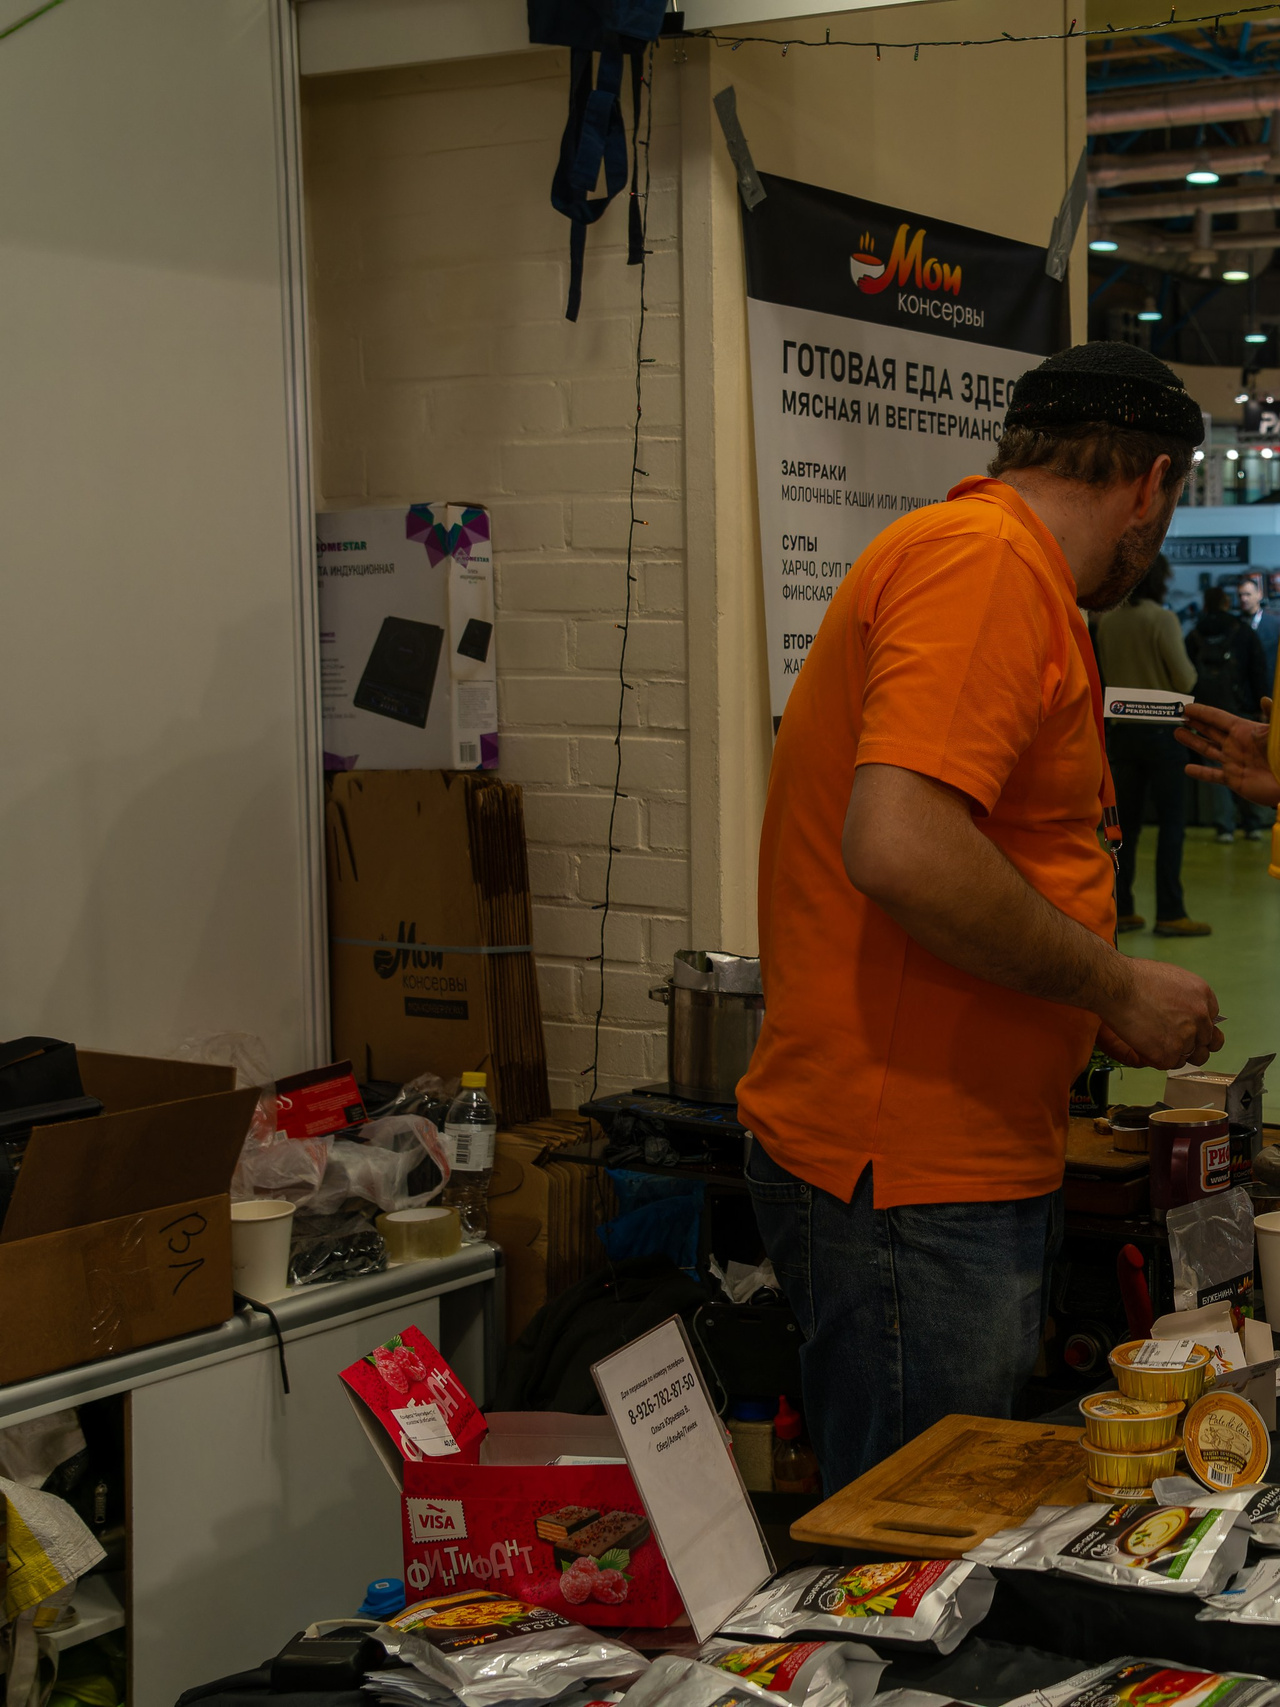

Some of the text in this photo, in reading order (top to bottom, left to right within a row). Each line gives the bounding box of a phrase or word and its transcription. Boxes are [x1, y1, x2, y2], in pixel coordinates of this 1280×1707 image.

[897, 292, 984, 328] консервы
[783, 340, 896, 391] ГОТОВАЯ
[906, 361, 953, 402] ЕДА
[782, 389, 861, 424] МЯСНАЯ
[867, 402, 879, 426] И
[781, 459, 847, 482] ЗАВТРАКИ
[781, 485, 842, 506] МОЛОЧНЫЕ
[845, 491, 875, 508] КАШИ
[877, 493, 897, 510] ИЛИ
[782, 535, 818, 552] СУПЫ
[782, 559, 818, 579] ХАРЧО,
[821, 561, 842, 578] СУП
[782, 584, 832, 601] ФИНСКАЯ
[783, 633, 816, 650] ВТОР
[402, 975, 468, 997] консервы
[1202, 1288, 1234, 1305] БУЖЕНИНА
[653, 1366, 669, 1381] номеру
[666, 1357, 685, 1372] телефона
[628, 1372, 695, 1425] 8-926-782-87-50
[650, 1420, 667, 1435] Ольга
[664, 1409, 685, 1427] Юрьевна
[1213, 1462, 1228, 1472] ГОСТ
[418, 1514, 455, 1530] VISA
[406, 1539, 534, 1591] ФИНТИФАНТ
